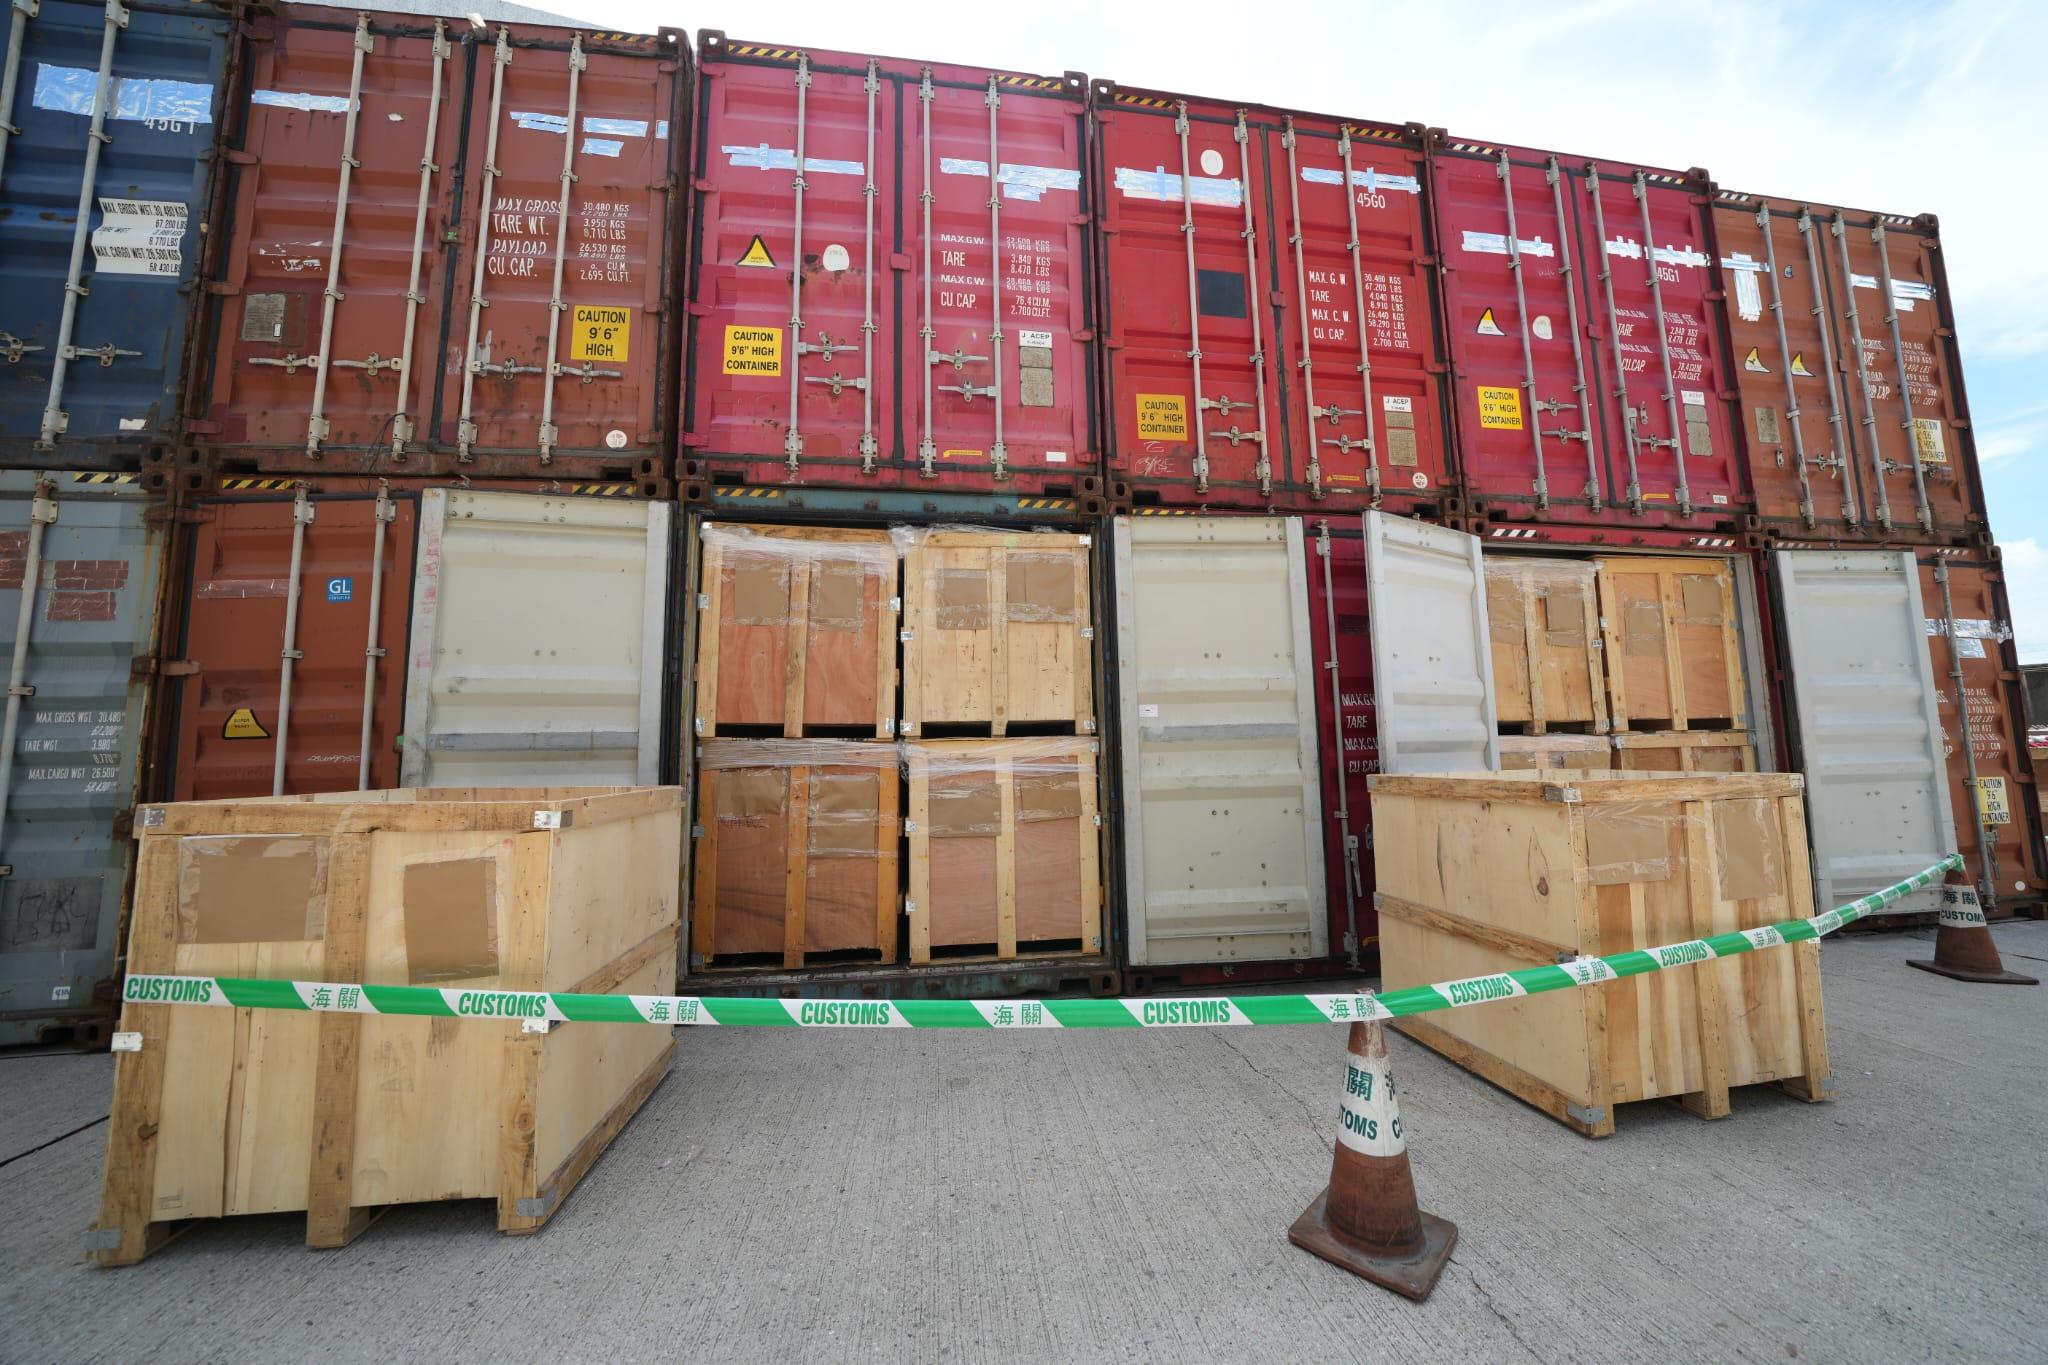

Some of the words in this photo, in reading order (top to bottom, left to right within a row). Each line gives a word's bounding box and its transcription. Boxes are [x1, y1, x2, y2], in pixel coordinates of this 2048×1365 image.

[496, 198, 522, 211] MAX
[524, 199, 562, 214] GROSS
[583, 202, 610, 212] 30.480
[614, 203, 630, 212] KGS
[493, 213, 523, 234] TARE
[528, 216, 550, 236] WT.
[583, 219, 606, 228] 3.950
[610, 220, 626, 229] KGS
[583, 228, 607, 239] 8.710
[610, 229, 626, 240] LBS
[166, 237, 179, 247] LBS
[491, 239, 547, 256] PAYLOAD
[579, 243, 607, 253] 26.530
[610, 244, 626, 254] KGS
[940, 250, 966, 267] TARE
[1011, 254, 1031, 264] 3.840
[1035, 255, 1051, 266] KGS
[580, 270, 603, 281] 2.695
[1010, 264, 1031, 275] 8.470
[1035, 267, 1050, 277] LBS
[1656, 267, 1681, 283] 45G1
[1389, 276, 1402, 285] KGS
[1390, 285, 1402, 293] LBS
[1310, 289, 1330, 302] TARE
[1391, 294, 1404, 303] KGS
[1010, 305, 1031, 316] 2.700
[1391, 303, 1404, 311] LBS
[577, 310, 626, 324] CAUTION
[1392, 312, 1405, 321] KGS
[1393, 321, 1406, 330] LBS
[1617, 322, 1635, 337] TARE
[733, 331, 774, 342] CAUTION
[585, 343, 614, 357] HIGH
[751, 346, 775, 357] HIGH
[726, 359, 779, 371] CONTAINER
[1483, 391, 1514, 401] CAUTION
[1144, 401, 1179, 411] CAUTION
[1499, 404, 1517, 413] HIGH
[1164, 413, 1183, 422] HIGH
[1482, 415, 1521, 425] CONTAINER
[1140, 424, 1185, 434] CONTAINER
[329, 579, 351, 593] GL
[54, 711, 76, 723] GROSS
[1346, 715, 1368, 729] TARE
[24, 740, 41, 752] TARE
[43, 739, 58, 751] WGT
[47, 767, 69, 780] CARGO
[71, 767, 86, 779] WGT
[1979, 779, 2002, 789] CAUTION
[1981, 812, 2010, 823] CONTAINER
[1659, 940, 1708, 967] CUSTOMS
[1576, 960, 1607, 983] 海關
[126, 977, 213, 1003] CUSTOMS
[1449, 977, 1514, 1004] CUSTOMS
[311, 987, 361, 1010] 海關
[458, 992, 548, 1018] CUSTOMS
[649, 1000, 699, 1022] 海關
[1329, 997, 1376, 1018] 海關
[800, 1002, 890, 1026] CUSTOMS
[993, 1002, 1042, 1025] 海關
[1143, 1001, 1231, 1025] CUSTOMS
